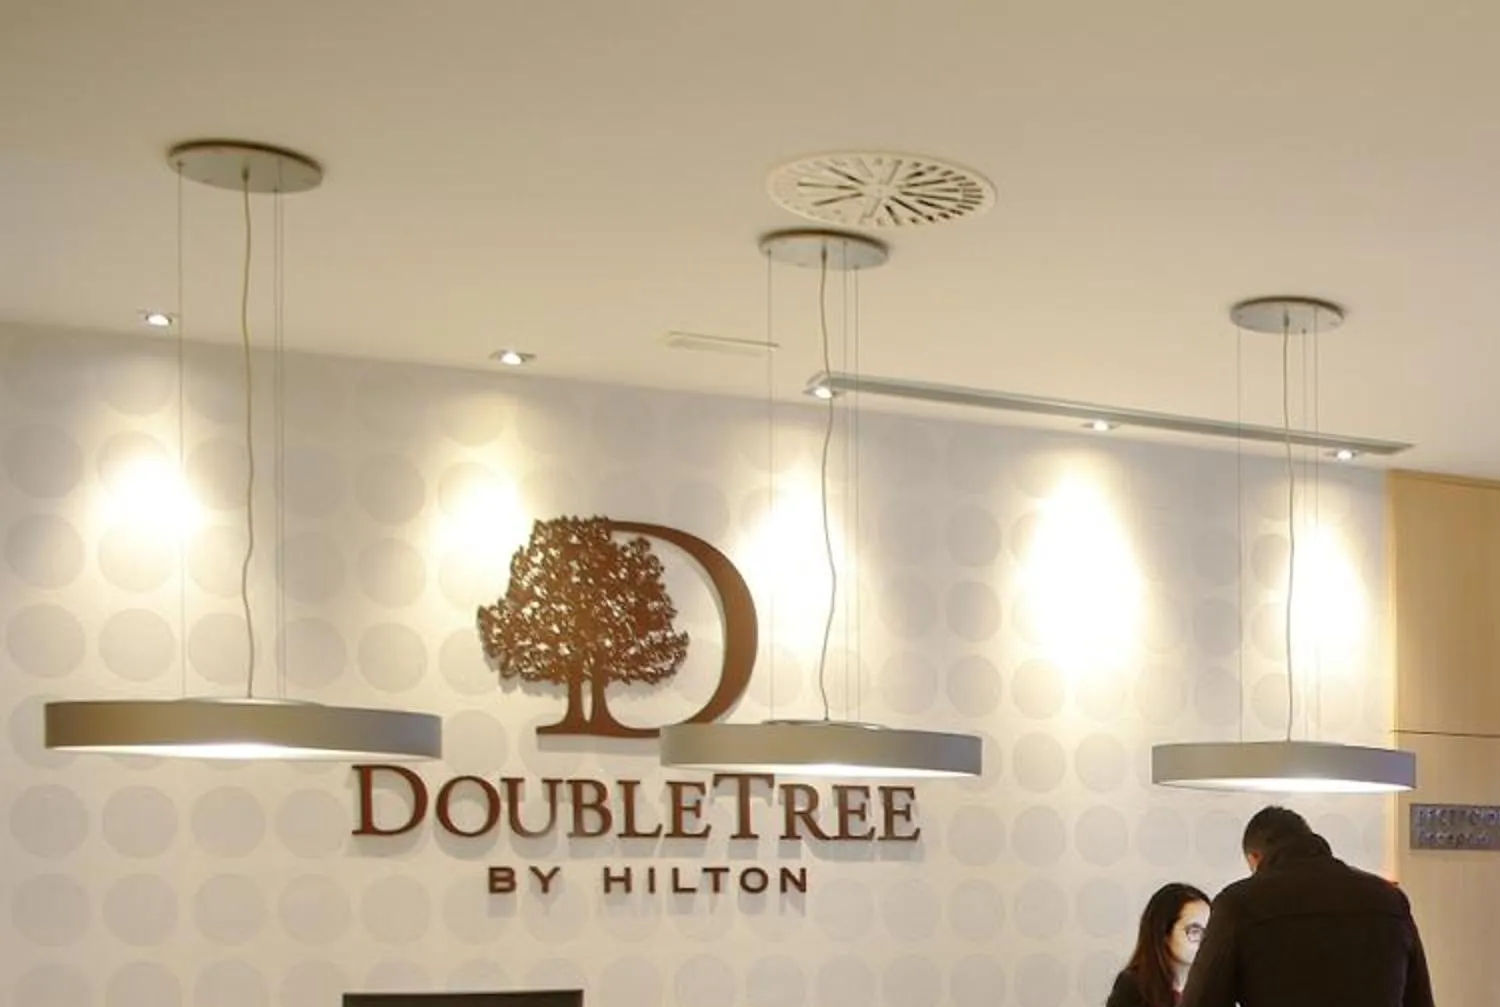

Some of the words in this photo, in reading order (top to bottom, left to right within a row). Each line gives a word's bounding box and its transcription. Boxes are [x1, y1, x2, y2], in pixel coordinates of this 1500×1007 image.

[351, 764, 921, 842] DOUBLETREE
[488, 867, 560, 894] BY
[603, 867, 808, 894] HILTON
